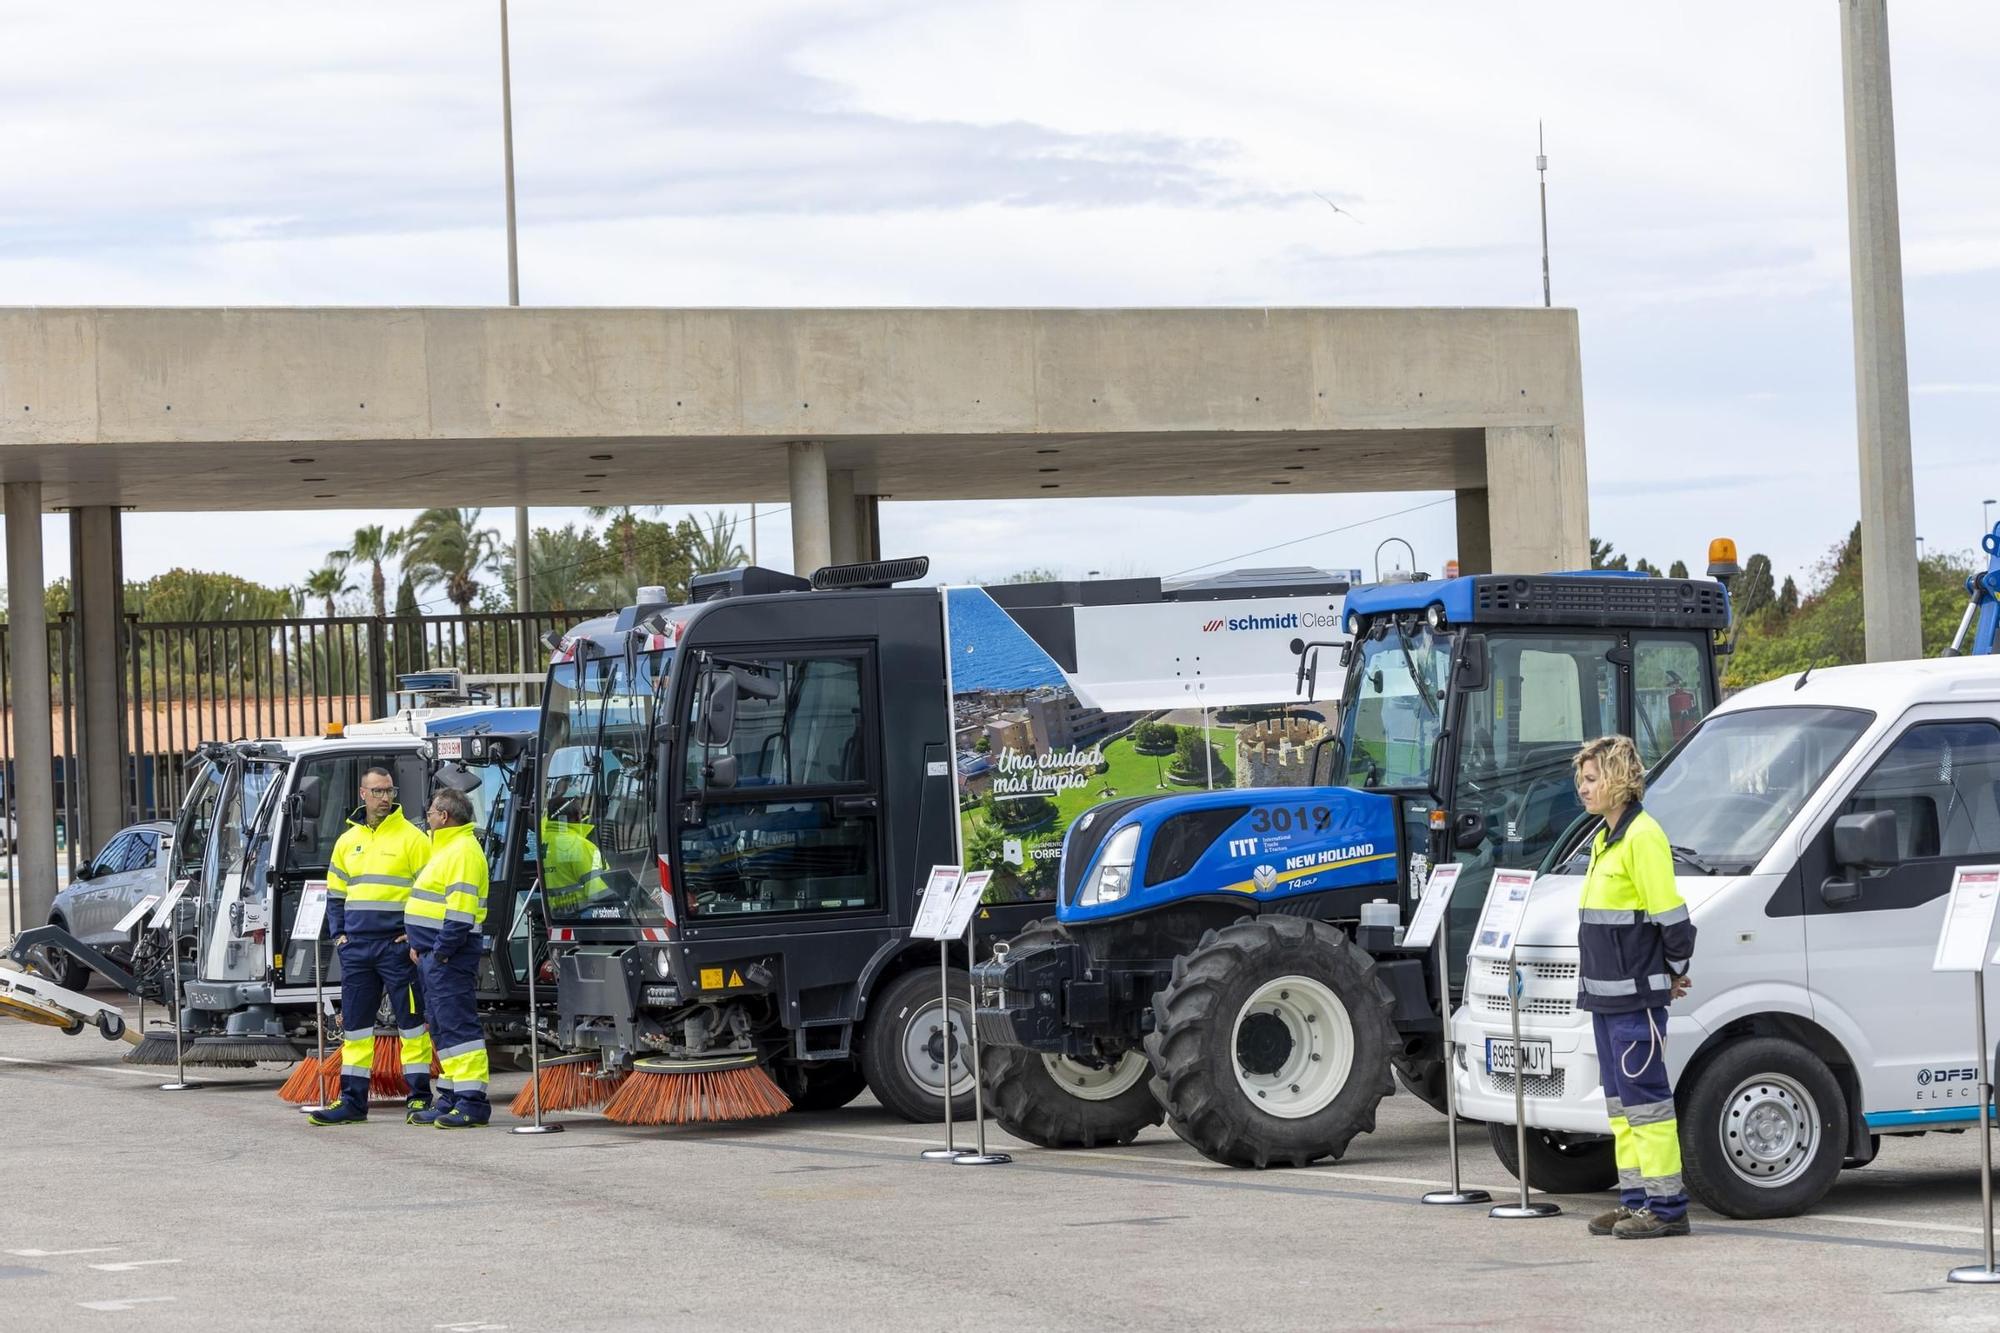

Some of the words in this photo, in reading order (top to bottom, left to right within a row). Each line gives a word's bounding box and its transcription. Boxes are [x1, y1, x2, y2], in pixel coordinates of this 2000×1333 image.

[1229, 613, 1298, 631] schmidt
[998, 746, 1037, 774] Una
[1038, 743, 1104, 768] ciudad
[993, 771, 1028, 793] más
[1031, 768, 1089, 797] limpia
[1251, 806, 1331, 833] 3019
[1028, 849, 1063, 859] TORRE
[1286, 853, 1316, 870] NEW
[1318, 843, 1374, 864] HOLLAND
[1522, 1046, 1545, 1070] MJY
[1934, 1068, 1978, 1082] DFS
[1916, 1088, 1979, 1100] ELEC
